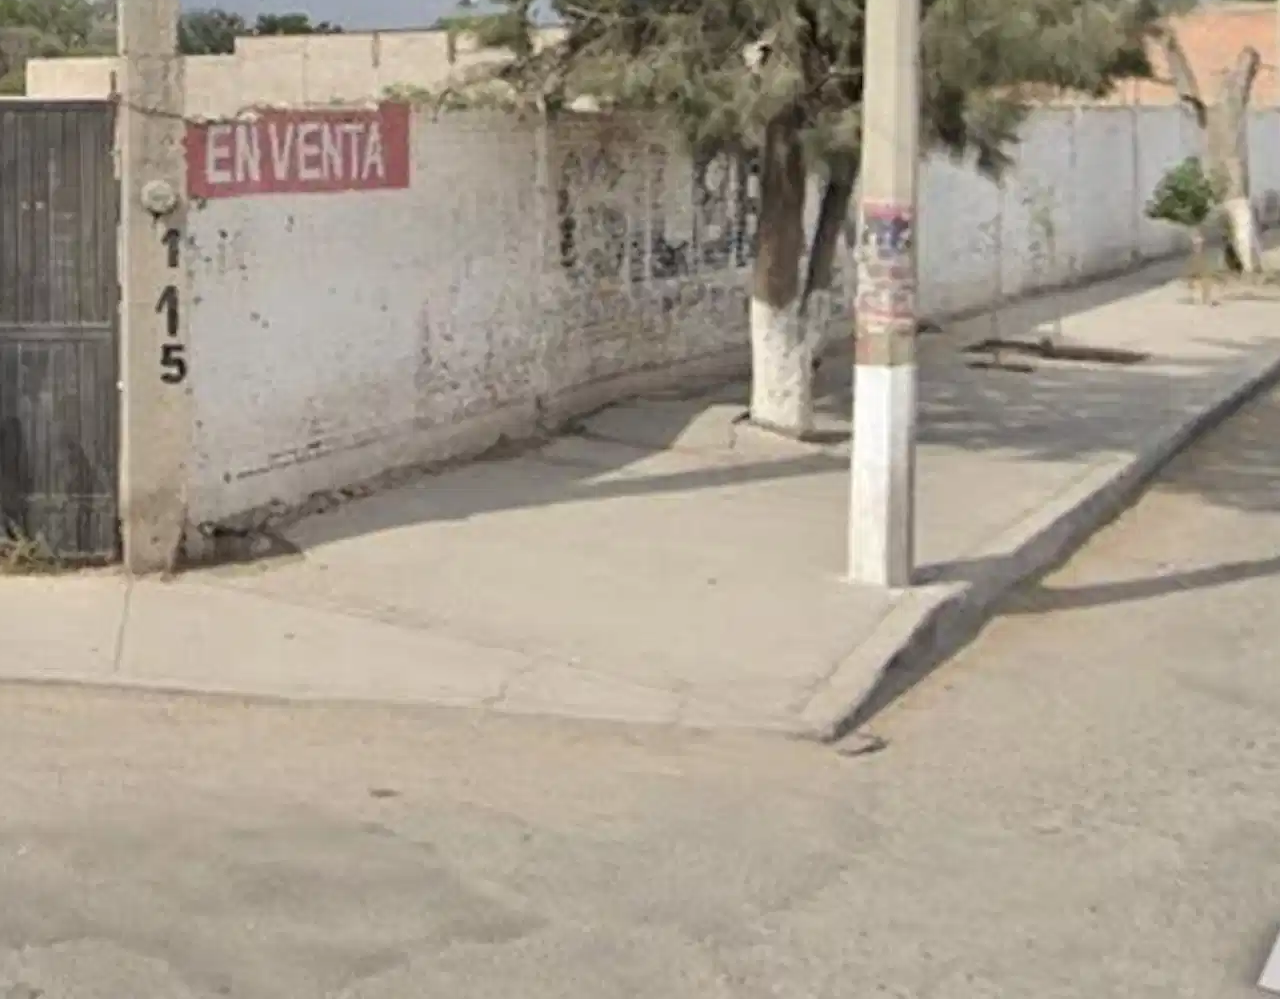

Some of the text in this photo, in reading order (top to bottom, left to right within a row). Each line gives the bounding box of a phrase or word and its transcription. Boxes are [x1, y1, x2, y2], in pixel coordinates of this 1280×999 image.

[204, 120, 386, 184] EN VENTA
[154, 227, 188, 386] 115
